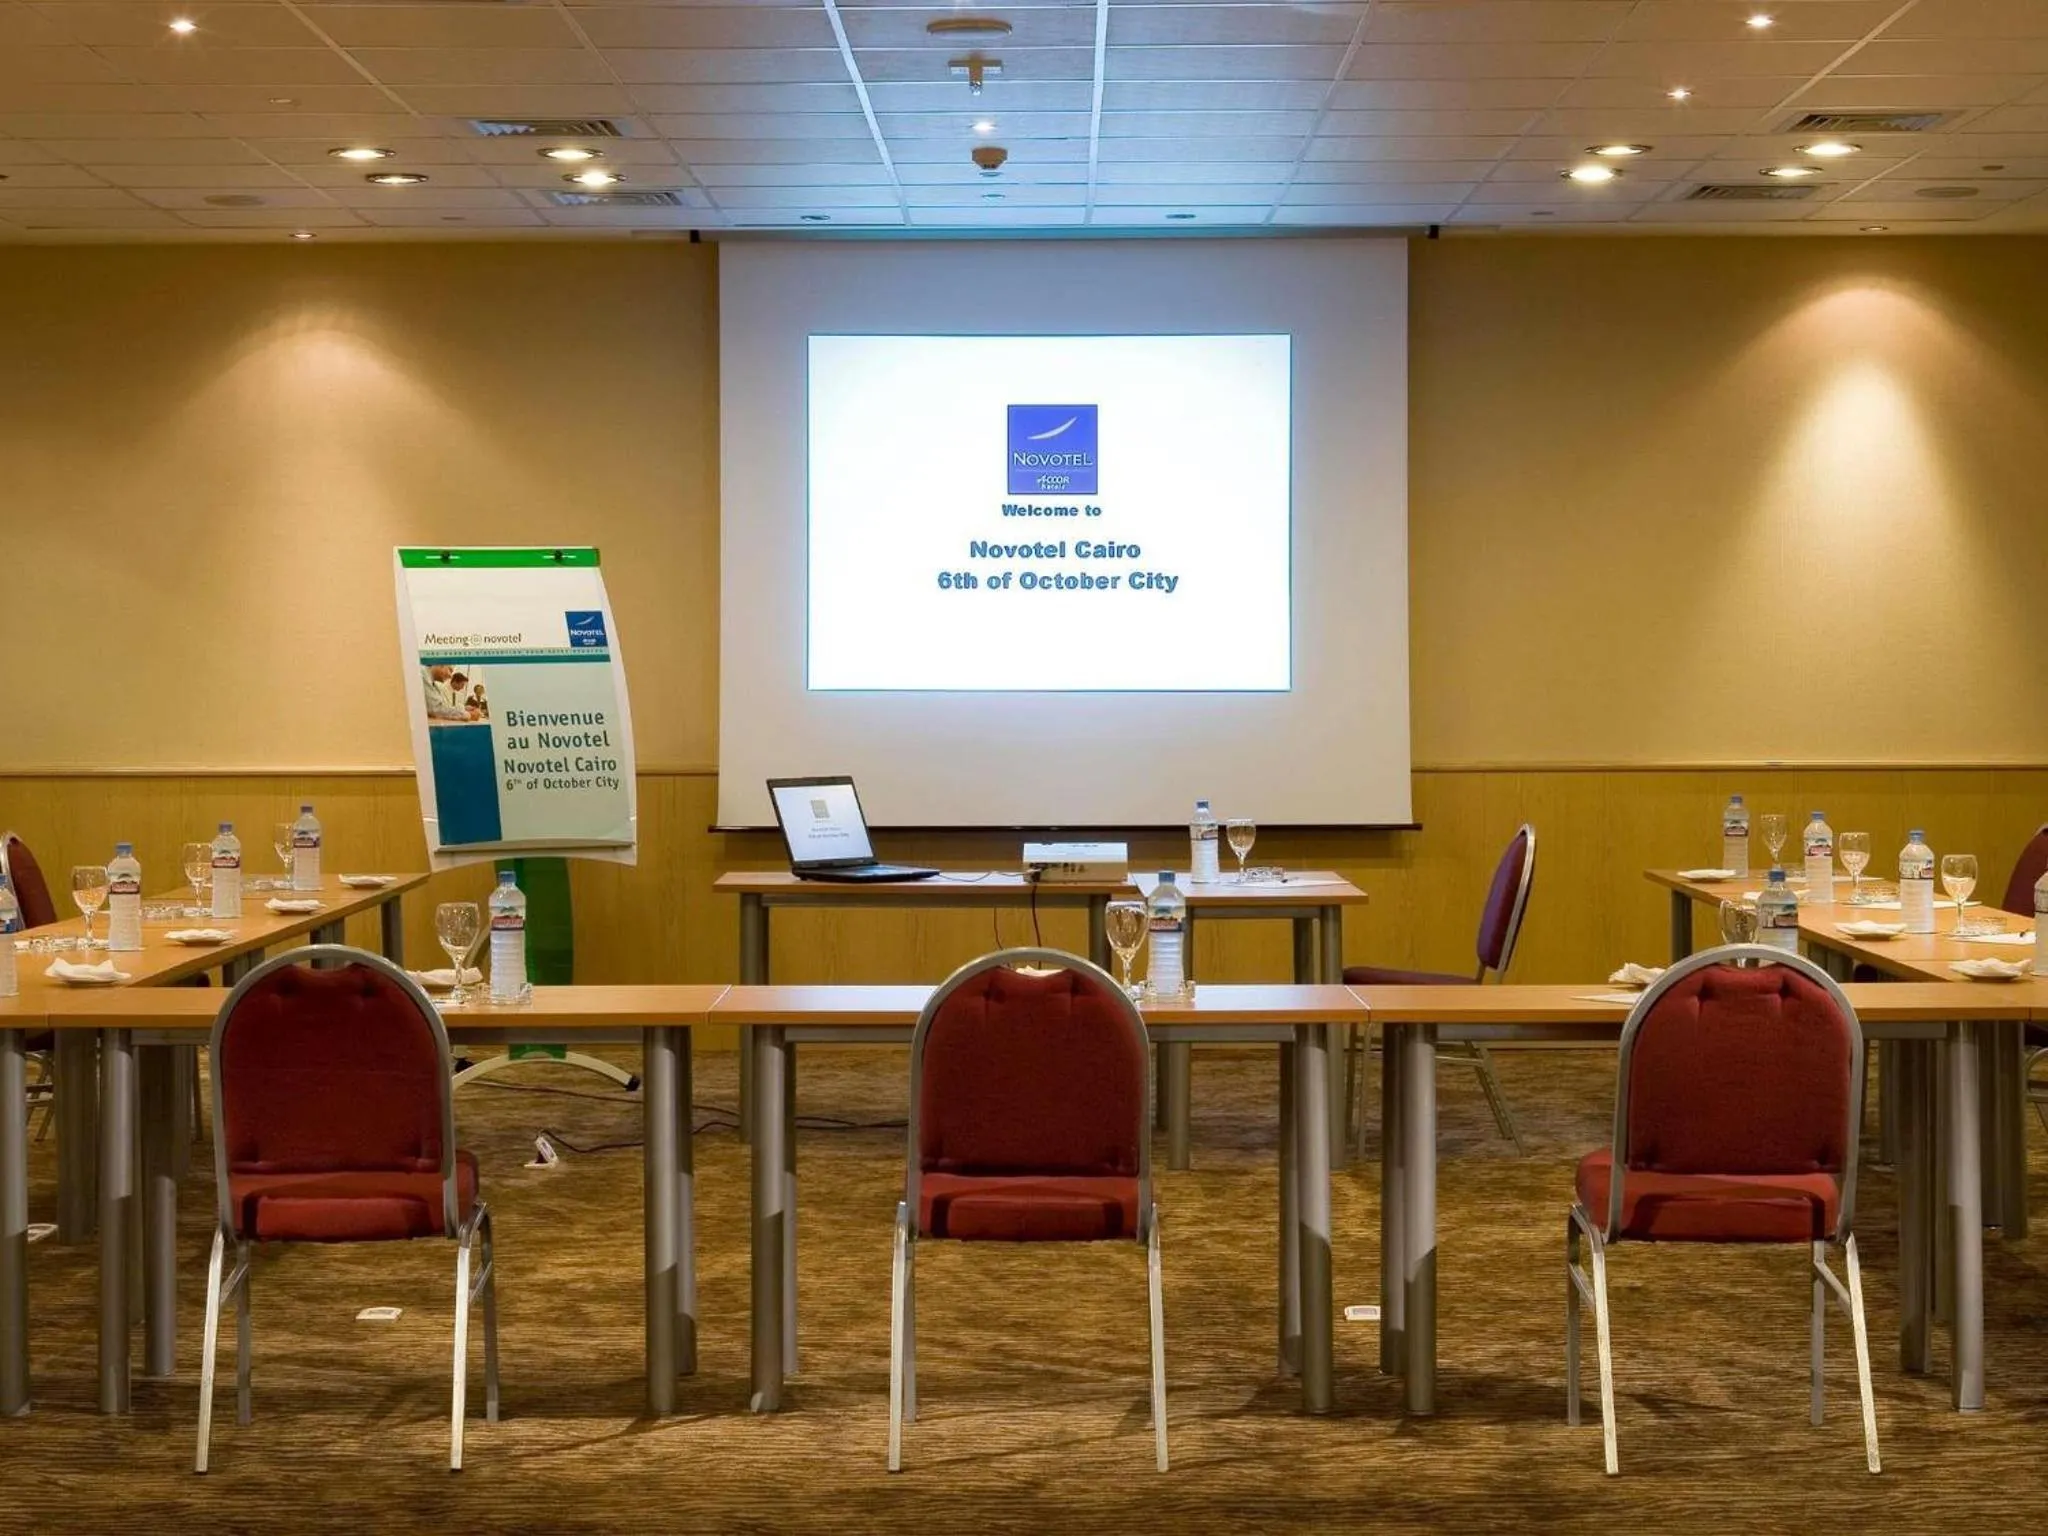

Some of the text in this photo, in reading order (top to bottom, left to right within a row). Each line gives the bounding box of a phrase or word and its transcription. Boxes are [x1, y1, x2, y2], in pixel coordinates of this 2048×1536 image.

[1013, 451, 1093, 467] NOVOTEL
[1001, 504, 1102, 517] Welcome to
[970, 540, 1142, 559] Novotel Cairo
[937, 571, 1179, 593] 6th of October City
[506, 710, 605, 727] Bienvenue
[507, 730, 610, 749] au Novotel
[503, 755, 617, 774] Novotel Cairo
[526, 778, 538, 790] of
[543, 777, 592, 790] October
[595, 776, 619, 790] City
